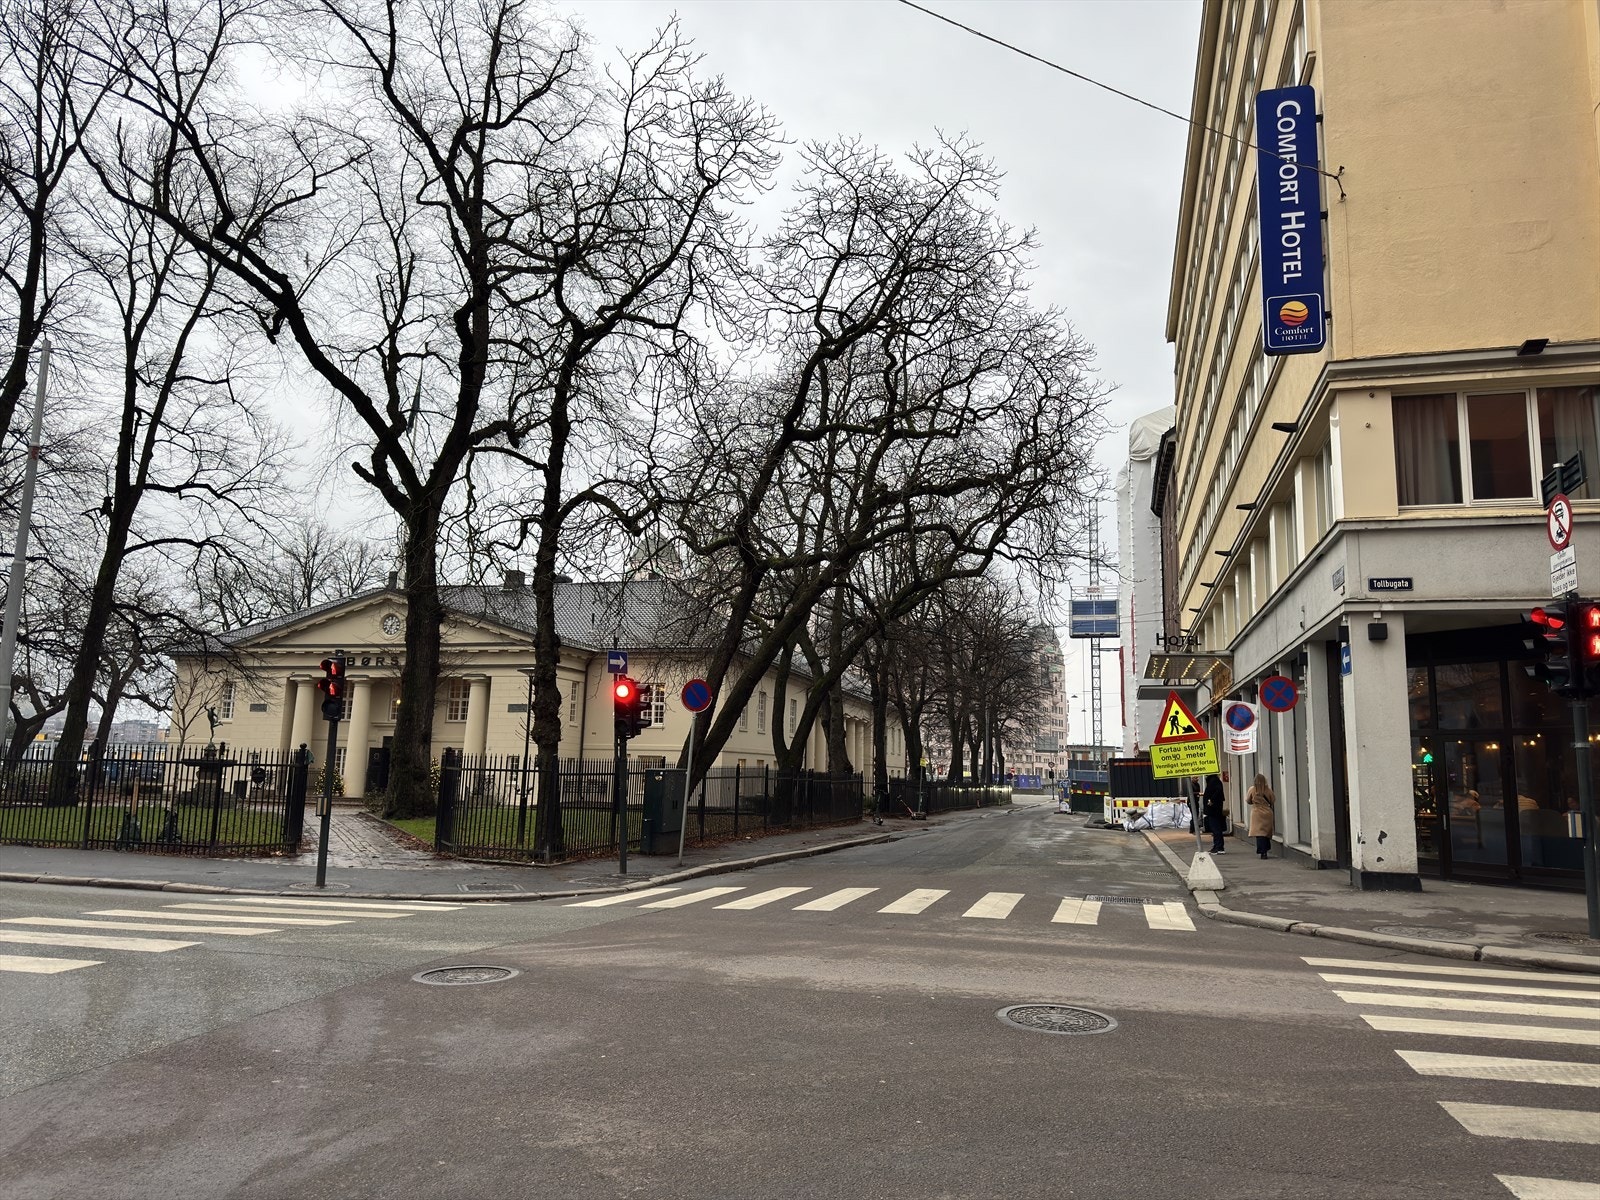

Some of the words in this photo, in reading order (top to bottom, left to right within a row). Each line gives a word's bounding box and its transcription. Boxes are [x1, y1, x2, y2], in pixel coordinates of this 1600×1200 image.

[1276, 100, 1302, 205] COMFORT
[1280, 211, 1306, 284] HOTEL
[1274, 325, 1314, 336] Comfort
[1373, 580, 1409, 589] Tollbugata
[1156, 633, 1202, 645] HOTEL
[346, 656, 399, 666] BØRS
[1183, 743, 1206, 751] stengt
